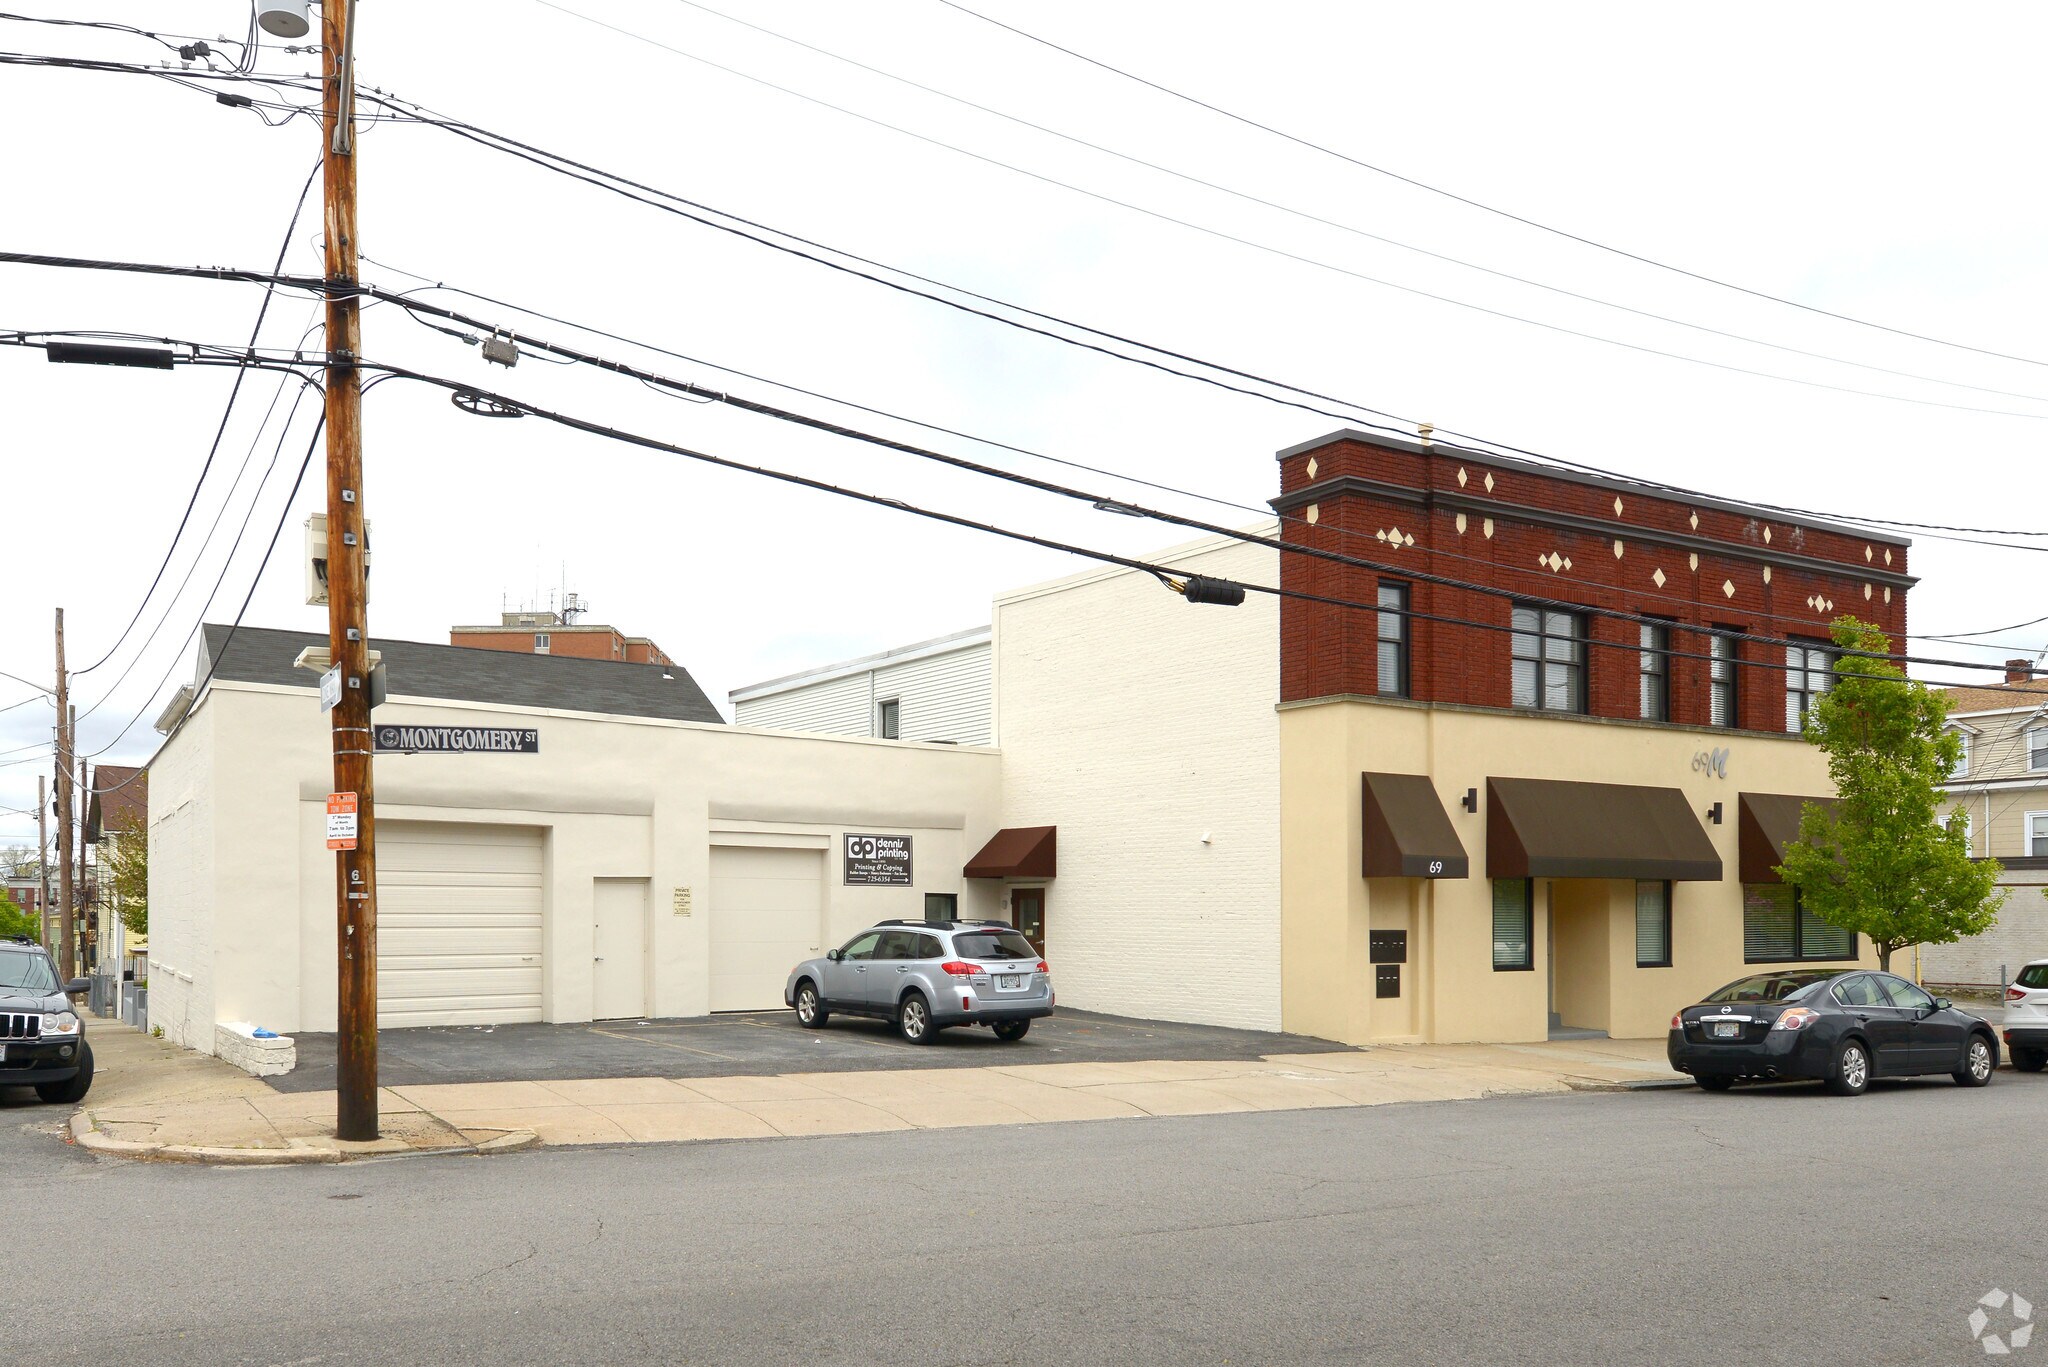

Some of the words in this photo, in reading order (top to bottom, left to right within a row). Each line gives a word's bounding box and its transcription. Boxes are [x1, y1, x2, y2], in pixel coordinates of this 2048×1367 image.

[400, 728, 523, 750] MONTGOMERY
[525, 731, 537, 742] ST
[337, 795, 356, 803] PARKING
[330, 805, 339, 813] TOW
[877, 838, 904, 848] dennis
[878, 848, 909, 860] printing
[854, 863, 875, 871] Printing
[882, 864, 903, 872] Copying
[1429, 861, 1443, 874] 69
[351, 869, 360, 881] 6
